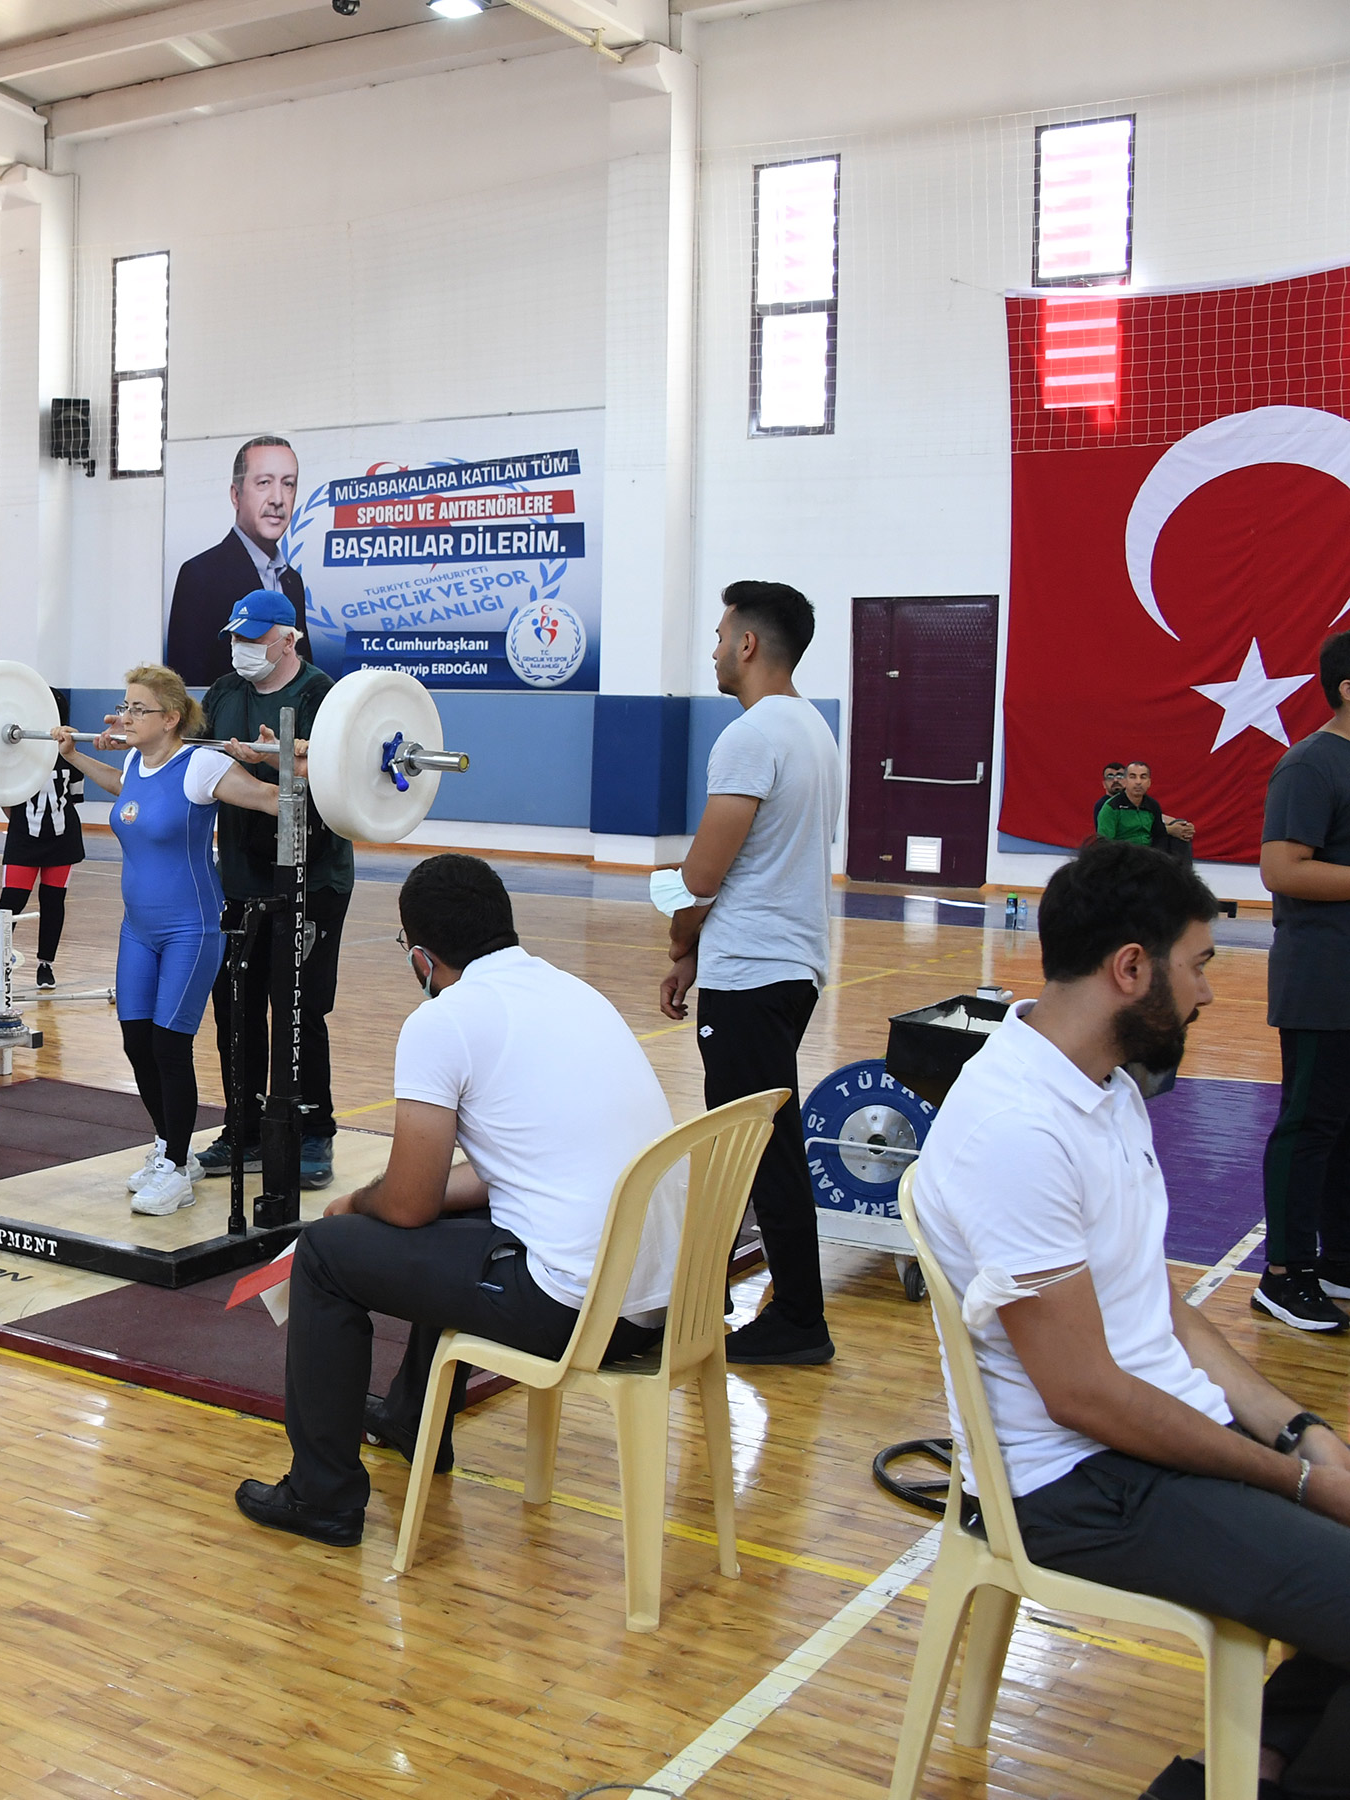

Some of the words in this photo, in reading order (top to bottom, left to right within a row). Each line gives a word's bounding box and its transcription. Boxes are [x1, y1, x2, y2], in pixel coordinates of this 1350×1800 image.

[334, 472, 458, 502] MÜSABAKALARA
[461, 464, 528, 486] KATILAN
[530, 455, 568, 476] TÜM
[357, 504, 414, 524] SPORCU
[418, 502, 435, 521] VE
[438, 495, 554, 520] ANTRENÖRLERE
[331, 533, 454, 567] BAŞARILAR
[460, 524, 566, 556] DİLERİM.
[437, 582, 468, 599] VE
[470, 570, 530, 593] SPOR
[380, 594, 504, 632] BAKANLIĞI
[361, 638, 384, 650] T.C.
[386, 637, 488, 653] Cumhurbaşkanı
[432, 661, 488, 675] ERDOĞAN
[807, 1112, 826, 1133] 20
[808, 1158, 845, 1204] SAN
[853, 1199, 900, 1218] ERK
